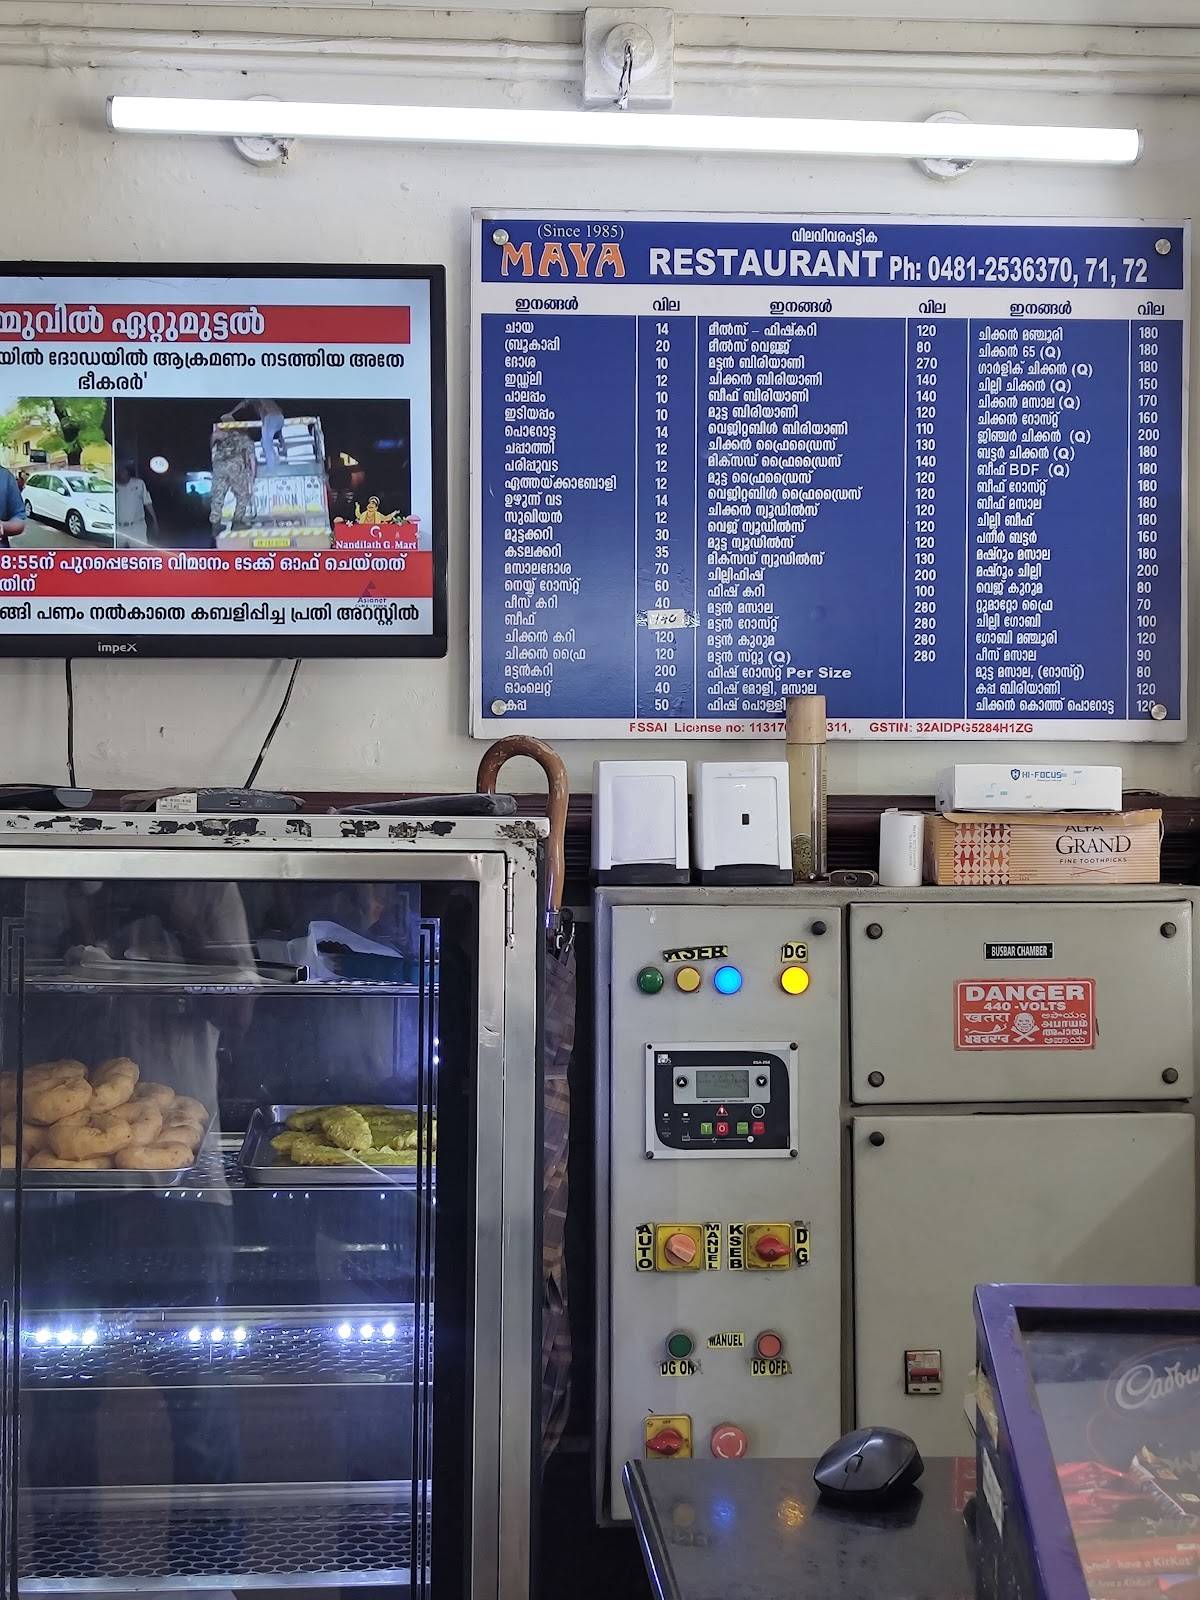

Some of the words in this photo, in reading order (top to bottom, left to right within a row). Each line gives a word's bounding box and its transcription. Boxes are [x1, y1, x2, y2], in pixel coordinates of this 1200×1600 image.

[538, 224, 580, 240] (Since
[586, 224, 624, 240] 1985)
[792, 228, 878, 246] വിലവിവരപട്ടിക
[501, 242, 626, 278] MAYA
[650, 248, 884, 278] RESTAURANT
[890, 258, 922, 281] Ph:
[928, 258, 1079, 287] 0481-2536370,
[1085, 258, 1117, 288] 71,
[1123, 258, 1148, 284] 72
[516, 296, 578, 312] ഇനങ്ങൾ
[652, 297, 680, 312] വില
[770, 299, 832, 314] ഇനങ്ങൾ
[919, 299, 946, 314] വില
[1010, 301, 1072, 316] ഇനങ്ങൾ
[1138, 302, 1164, 316] വില
[112, 306, 266, 343] ഏറ്റുമുട്ടൽ
[505, 321, 534, 334] ചായ
[656, 322, 669, 335] 14
[708, 321, 748, 336] മീൽസ്
[916, 324, 936, 337] 120
[978, 326, 1018, 341] ചിക്കൻ
[1138, 326, 1158, 339] 180
[48, 346, 148, 366] ദോഡയിൽ
[153, 352, 256, 370] ആക്രമണം
[261, 348, 344, 368] നടത്തിയ
[349, 353, 404, 368] അതേ
[504, 356, 536, 368] ദോശ
[656, 357, 668, 370] 10
[656, 374, 668, 387] 12
[708, 370, 752, 386] ചിക്കൻ
[756, 370, 822, 386] ബിരിയാണി
[916, 374, 937, 386] 140
[978, 376, 1002, 392] ചില്ലി
[1006, 377, 1046, 392] ചിക്കൻ
[1050, 378, 1072, 394] (Q)
[1138, 378, 1158, 390] 150
[504, 425, 556, 442] പൊറോട്ട
[655, 426, 668, 438] 14
[782, 420, 848, 435] ബിരിയാണി
[916, 422, 934, 435] 110
[1138, 428, 1160, 441] 200
[1021, 428, 1062, 442] ചിക്കൻ
[1070, 429, 1091, 444] (Q)
[655, 477, 667, 490] 12
[708, 472, 728, 484] മുട്ട
[915, 472, 935, 484] 120
[977, 478, 1007, 493] ബീഫ്
[1009, 478, 1048, 496] റോസ്റ്റ്
[1137, 479, 1157, 492] 180
[707, 518, 740, 534] വെജ്
[915, 520, 935, 532] 120
[504, 526, 553, 544] മുട്ടക്കറി
[655, 528, 669, 541] 30
[976, 529, 1006, 544] പനീർ
[1009, 530, 1037, 546] ബട്ടർ
[1137, 530, 1157, 543] 160
[336, 540, 381, 549] Nandilath
[395, 540, 416, 549] Mart
[60, 556, 162, 574] പുറപ്പെടേണ്ട
[168, 552, 230, 570] വിമാനം
[234, 552, 275, 571] ടേക്ക്
[280, 552, 320, 571] ഓഫ്
[324, 552, 407, 571] ചെയ്തത്
[504, 562, 572, 575] മസാലദോശ
[708, 564, 766, 584] ചില്ലിഫിഷ്
[914, 569, 936, 581] 200
[539, 577, 582, 593] റോസ്റ്റ്
[654, 580, 669, 592] 60
[976, 580, 1006, 596] വെജ്
[1008, 582, 1043, 596] കുറുമ
[1136, 581, 1152, 594] 80
[37, 606, 84, 620] പണം
[90, 604, 185, 620] നൽകാതെ
[191, 603, 286, 624] കബളിപ്പിച്ച
[291, 604, 331, 622] പ്രതി
[336, 603, 419, 626] അറസ്റ്റിൽ
[707, 618, 733, 632] മട്ടൻ
[738, 616, 779, 632] റോസ്റ്റ്
[914, 617, 936, 630] 280
[505, 630, 548, 643] ചിക്കൻ
[552, 630, 575, 643] കറി
[655, 631, 674, 642] 120
[976, 630, 1013, 644] ഗോബി
[1136, 632, 1156, 644] 120
[707, 664, 738, 678] ഫിഷ്
[742, 666, 783, 682] റോസ്റ്റ്
[786, 667, 814, 678] Per
[818, 667, 852, 678] Size
[655, 682, 670, 694] 40
[975, 683, 996, 694] കപ്പ
[1000, 680, 1060, 695] ബിരിയാണി
[1136, 683, 1156, 695] 120
[629, 722, 666, 733] FSSAI
[674, 722, 722, 733] License
[725, 722, 744, 733] no:
[869, 722, 913, 733] GSTIN:
[1056, 835, 1131, 854] GRAND
[783, 944, 807, 959] DG
[991, 946, 1016, 956] BUSBAR
[1016, 945, 1048, 956] CHAMBER
[966, 985, 1084, 1002] DANGER
[984, 1002, 1011, 1011] 440
[638, 1225, 653, 1268] AUTO
[706, 1224, 720, 1269] MANUEL
[729, 1224, 743, 1269] KSEB
[796, 1228, 808, 1264] DG
[708, 1333, 743, 1347] MANUEL
[661, 1361, 676, 1375] DG
[753, 1361, 765, 1375] DG
[769, 1361, 788, 1375] OFF
